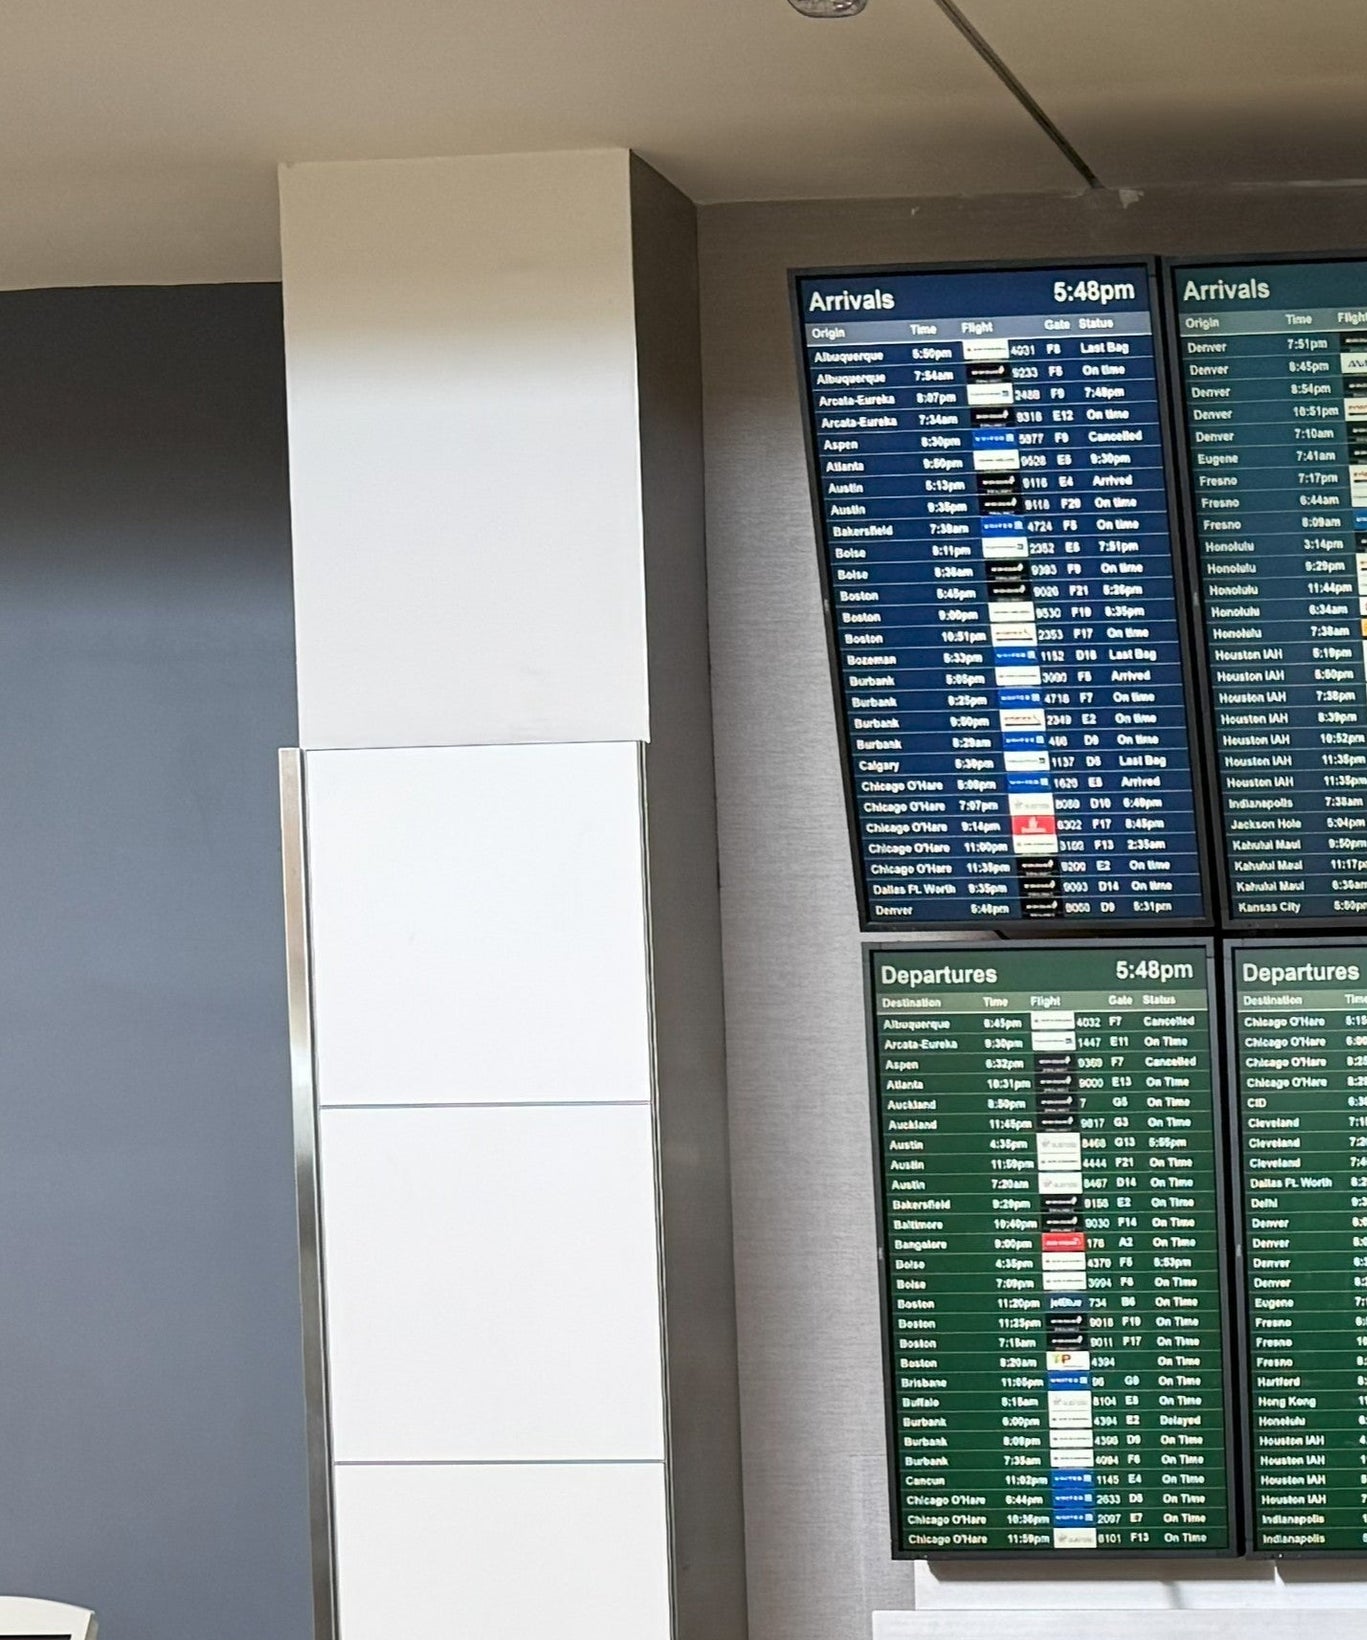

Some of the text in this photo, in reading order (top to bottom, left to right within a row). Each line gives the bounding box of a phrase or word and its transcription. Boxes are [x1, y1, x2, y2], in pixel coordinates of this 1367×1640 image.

[809, 280, 1134, 312] Arrivals 5:48pm
[1183, 278, 1270, 301] Arrivals
[1185, 317, 1219, 331] Origin
[1284, 313, 1312, 325] Time
[811, 317, 1113, 341] Origin Time Flight Gate Status
[1187, 342, 1226, 354] Denver
[823, 439, 858, 453] Aspen
[1197, 453, 1238, 467] Eugene
[1092, 474, 1132, 487] Arrived
[1199, 475, 1237, 487] Fresno
[858, 760, 899, 773] Calgary
[1230, 818, 1301, 830] Jackson Hole
[875, 905, 912, 916] Denver
[1238, 901, 1300, 914] Kansas City
[881, 960, 1193, 989] Departures 5:48pm
[1242, 963, 1359, 986] Departures
[882, 994, 1175, 1009] Destination Time Flight Gate Status
[1243, 994, 1302, 1006] Destination
[885, 1059, 918, 1072] Aspen
[1250, 1198, 1277, 1209] Delhi
[1252, 1257, 1290, 1269] Denver
[1254, 1297, 1294, 1310] Eugene
[897, 1318, 935, 1329] Boston
